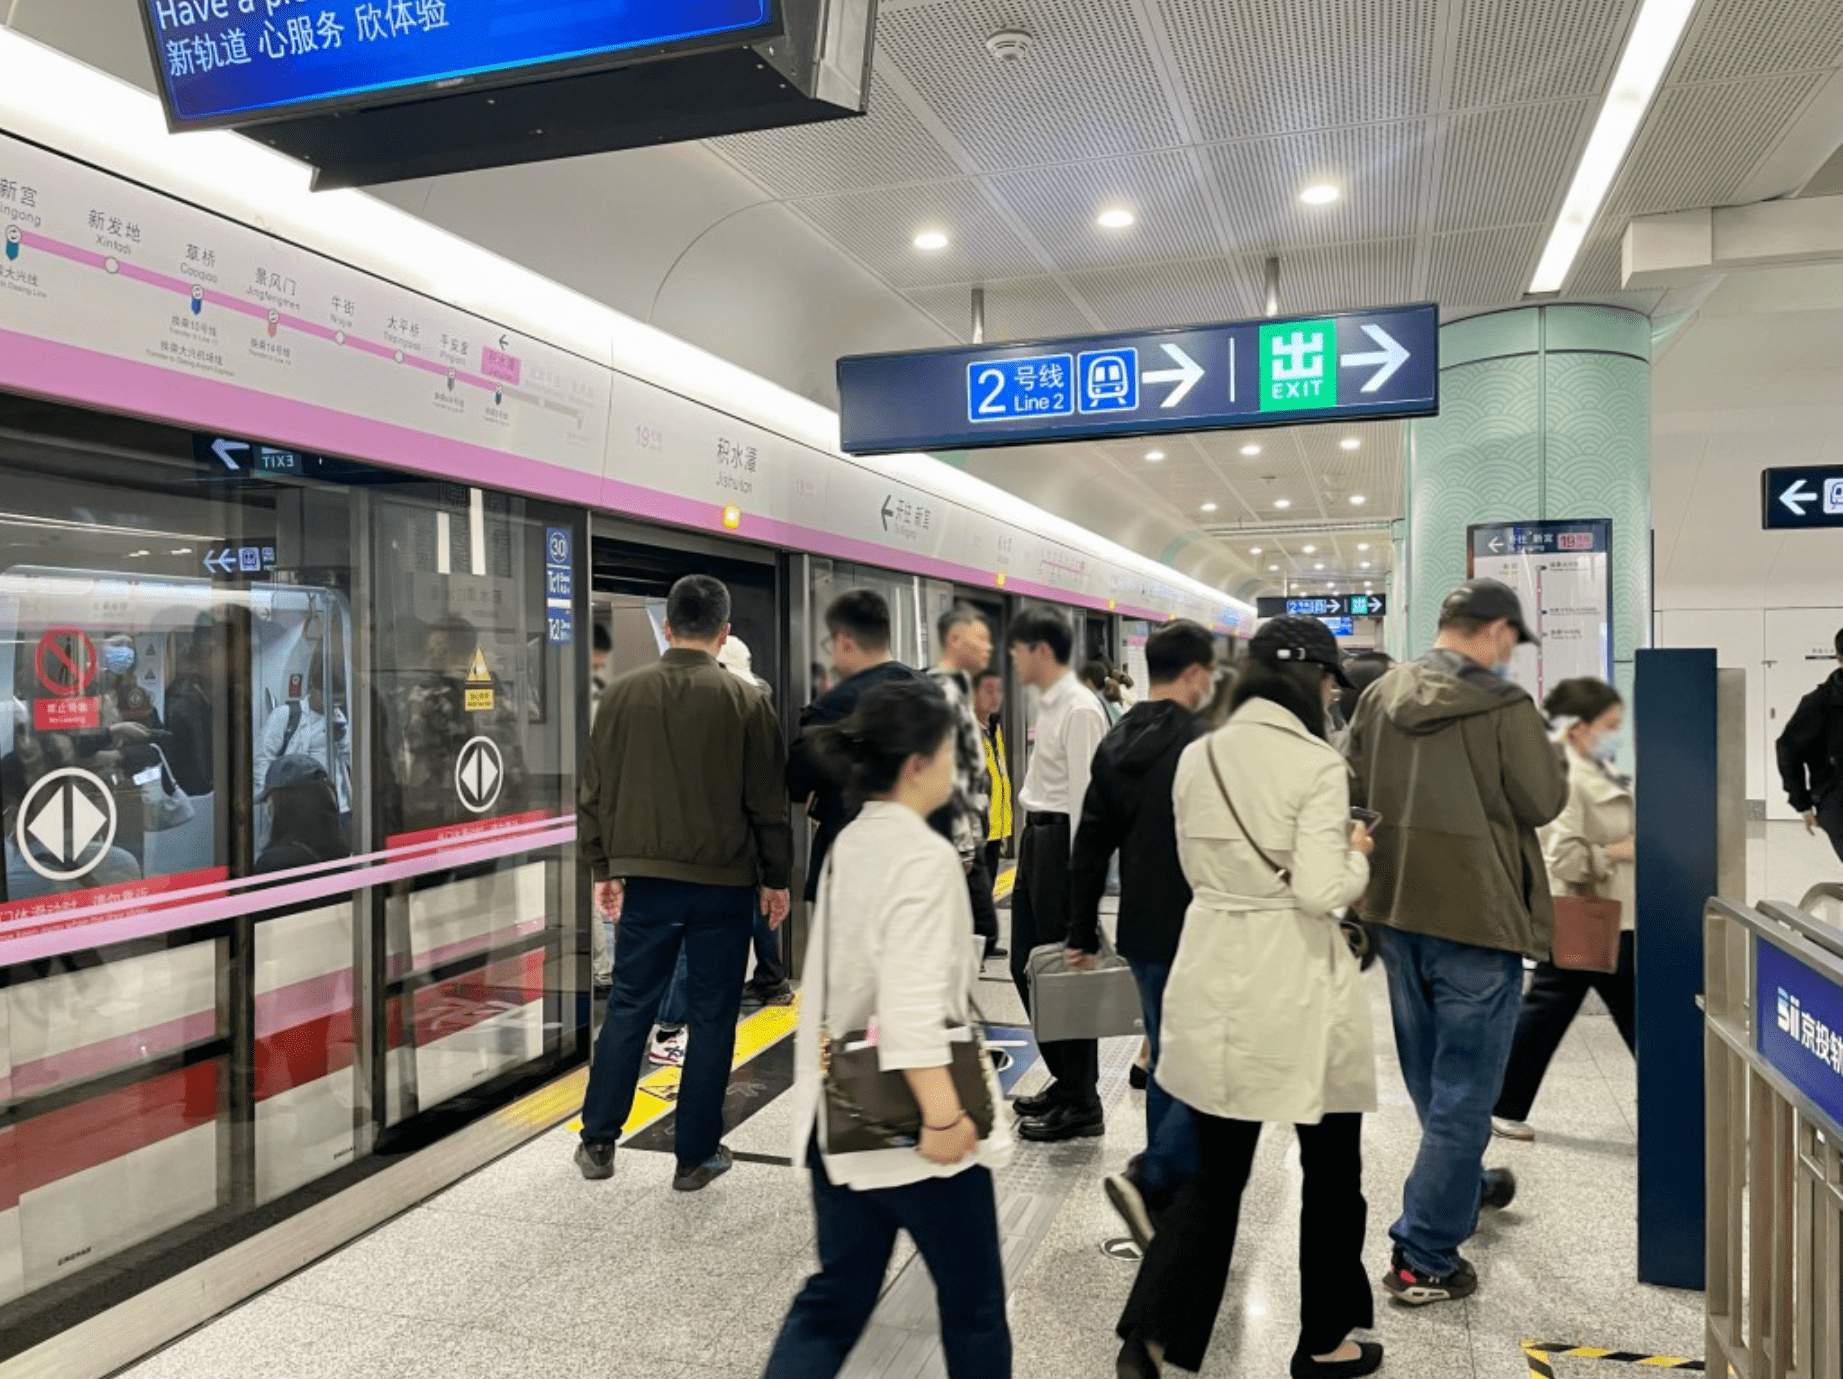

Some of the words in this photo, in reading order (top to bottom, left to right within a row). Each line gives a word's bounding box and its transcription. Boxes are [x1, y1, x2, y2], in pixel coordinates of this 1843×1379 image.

[156, 0, 229, 29] Have
[166, 27, 252, 77] 新轨道
[258, 10, 345, 60] 心服务
[355, 0, 449, 42] 欣体验
[0, 178, 37, 207] 新宫
[0, 202, 41, 228] ingong
[88, 209, 141, 243] 新发地
[186, 244, 216, 268] 草桥
[256, 268, 297, 296] 景风门
[1271, 331, 1323, 380] 出
[1014, 362, 1064, 390] 号线
[1271, 379, 1321, 399] EXIT
[976, 371, 1006, 414] 2
[1015, 394, 1048, 412] Line
[1053, 392, 1064, 409] 2
[716, 437, 758, 473] 积水潭
[552, 537, 565, 557] 30
